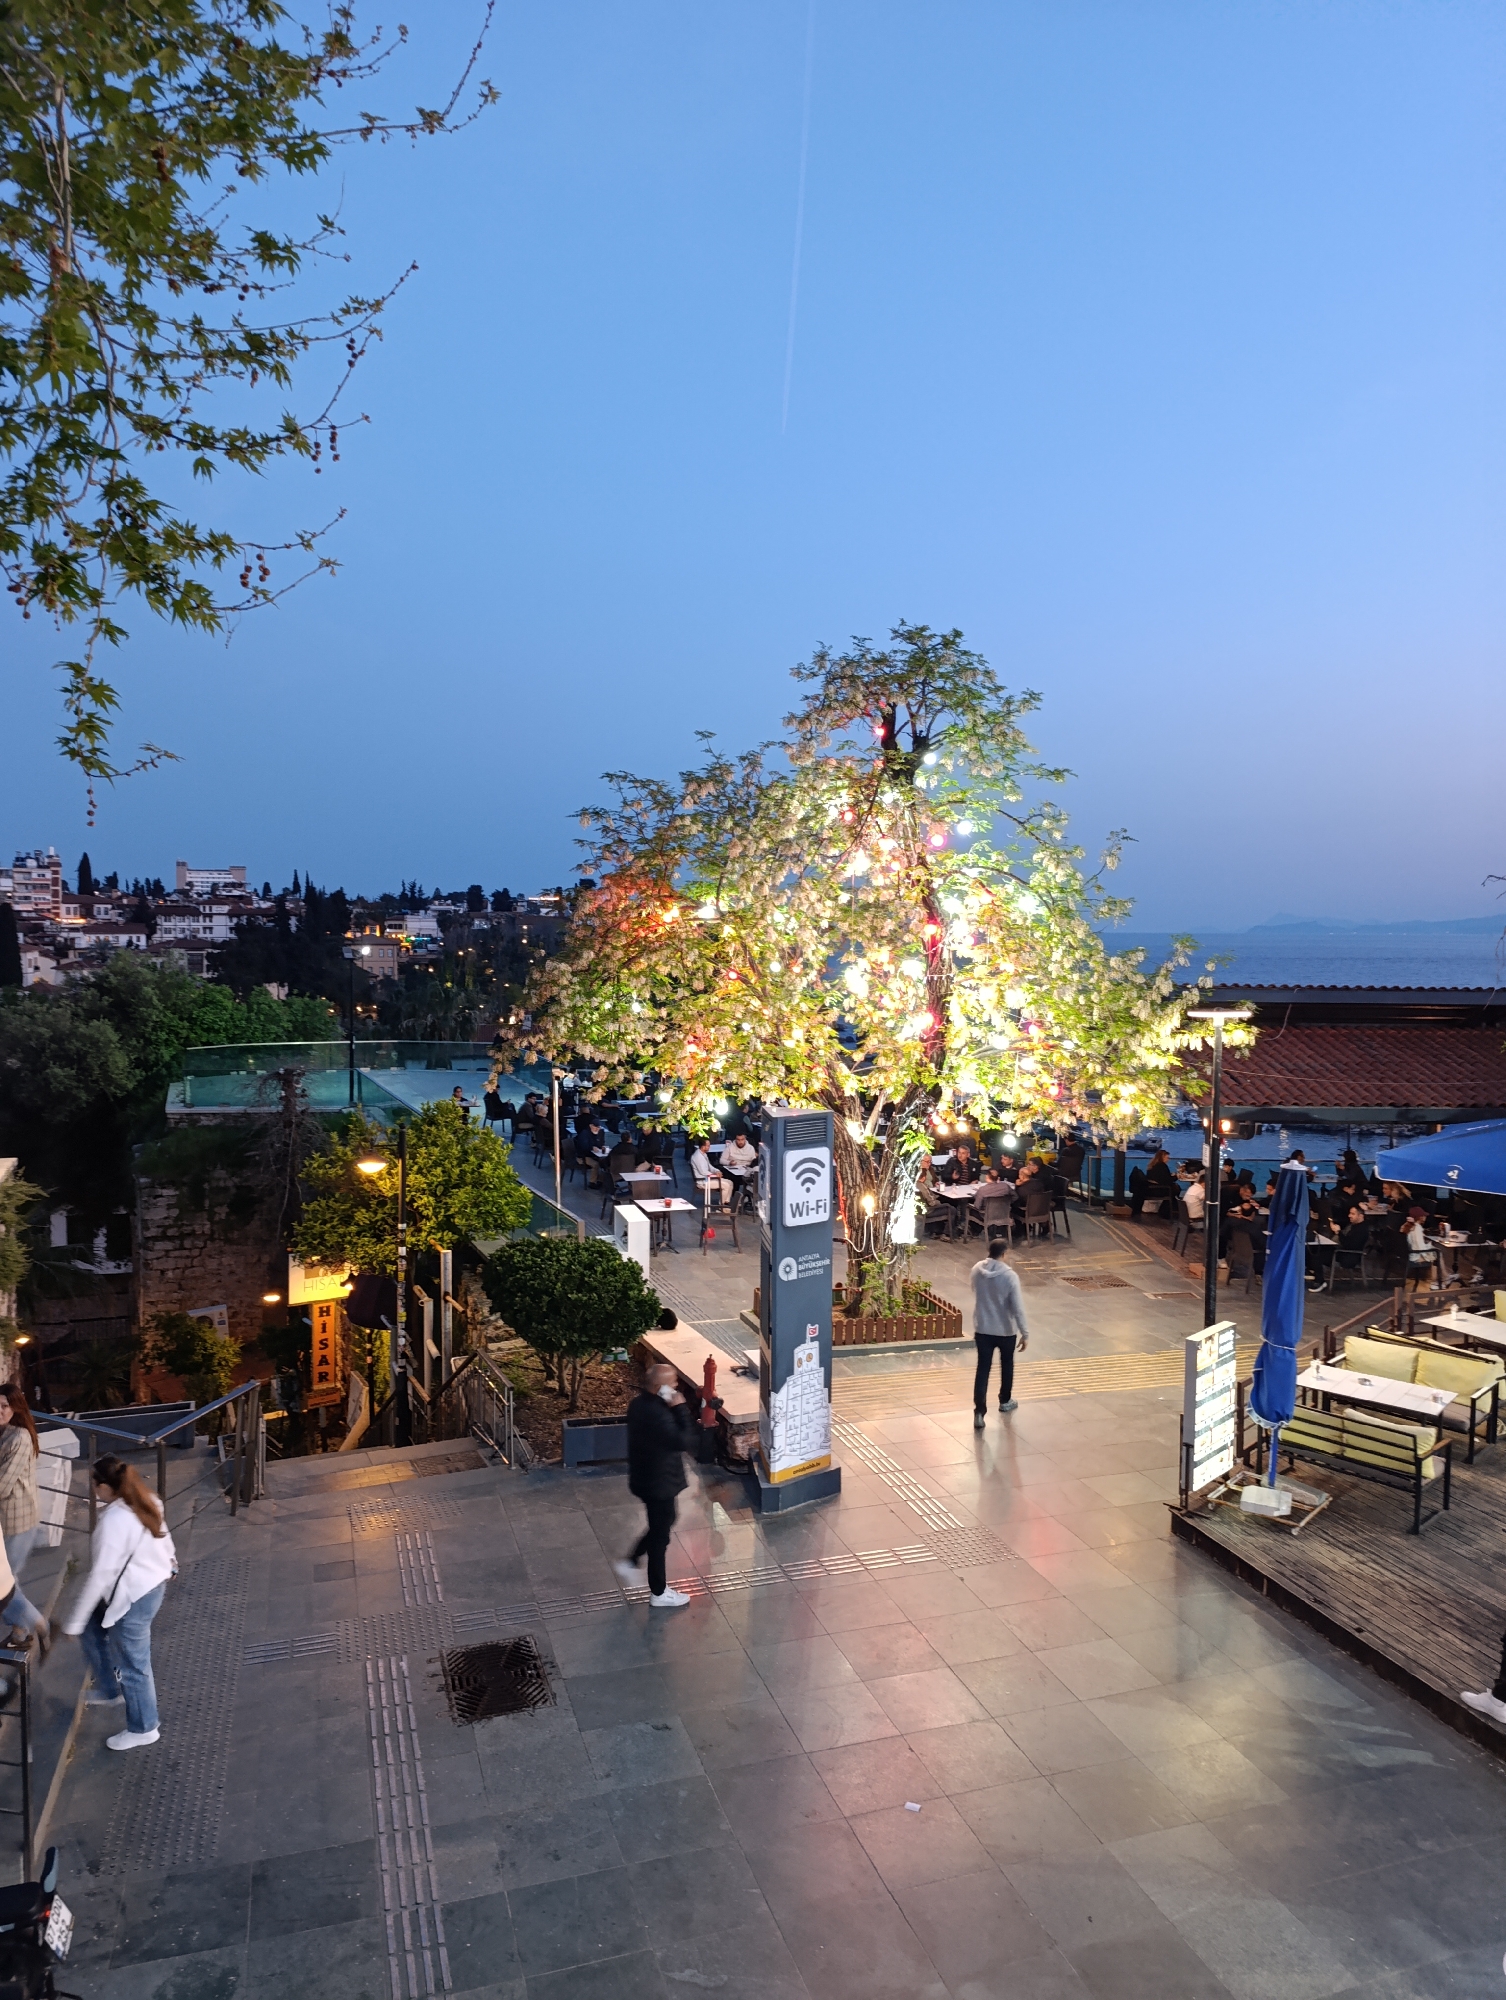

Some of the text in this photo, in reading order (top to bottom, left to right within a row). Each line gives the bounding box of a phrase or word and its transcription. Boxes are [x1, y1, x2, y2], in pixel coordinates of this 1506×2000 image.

[790, 1198, 827, 1218] Wi-Fi
[798, 1252, 820, 1263] ANTALYA
[798, 1257, 831, 1271] BÜYÜKŞEHİR
[798, 1267, 824, 1279] BELEDİYESİ
